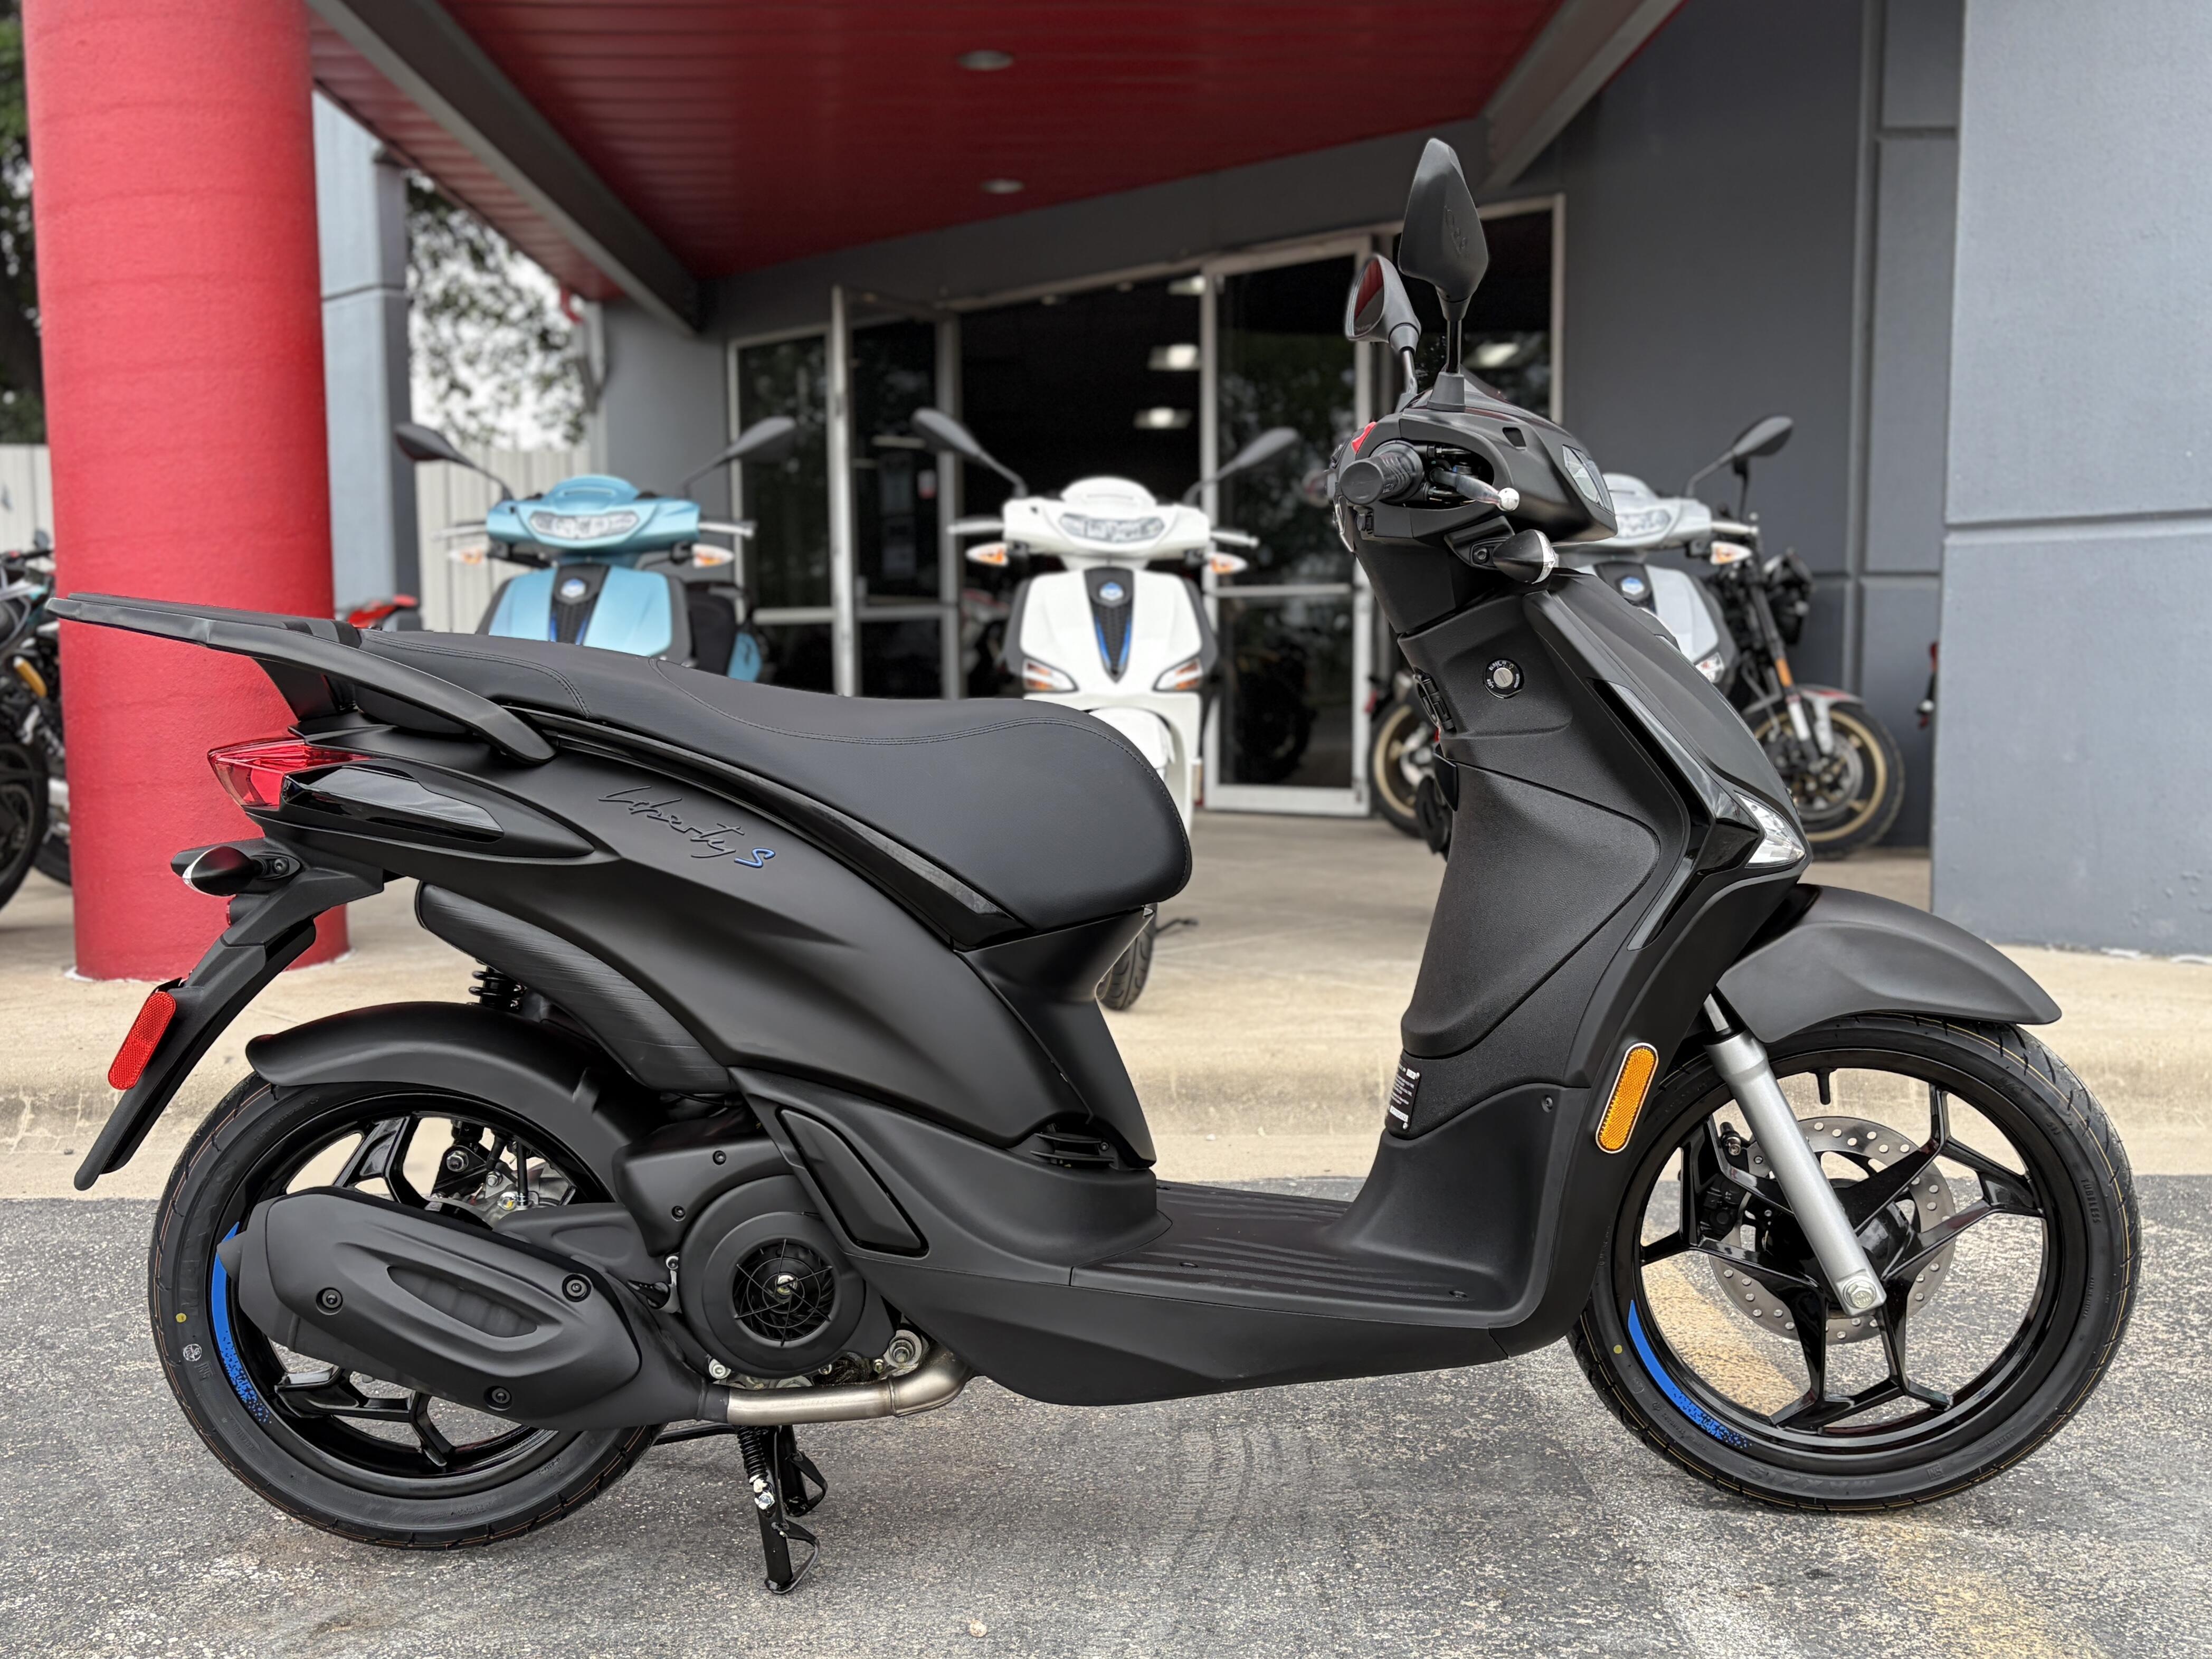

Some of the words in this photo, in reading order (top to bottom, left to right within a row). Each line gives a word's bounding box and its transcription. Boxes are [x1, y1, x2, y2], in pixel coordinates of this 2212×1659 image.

[599, 785, 745, 858] Liberty
[734, 847, 775, 868] S
[2081, 1178, 2102, 1225] TUBELESS
